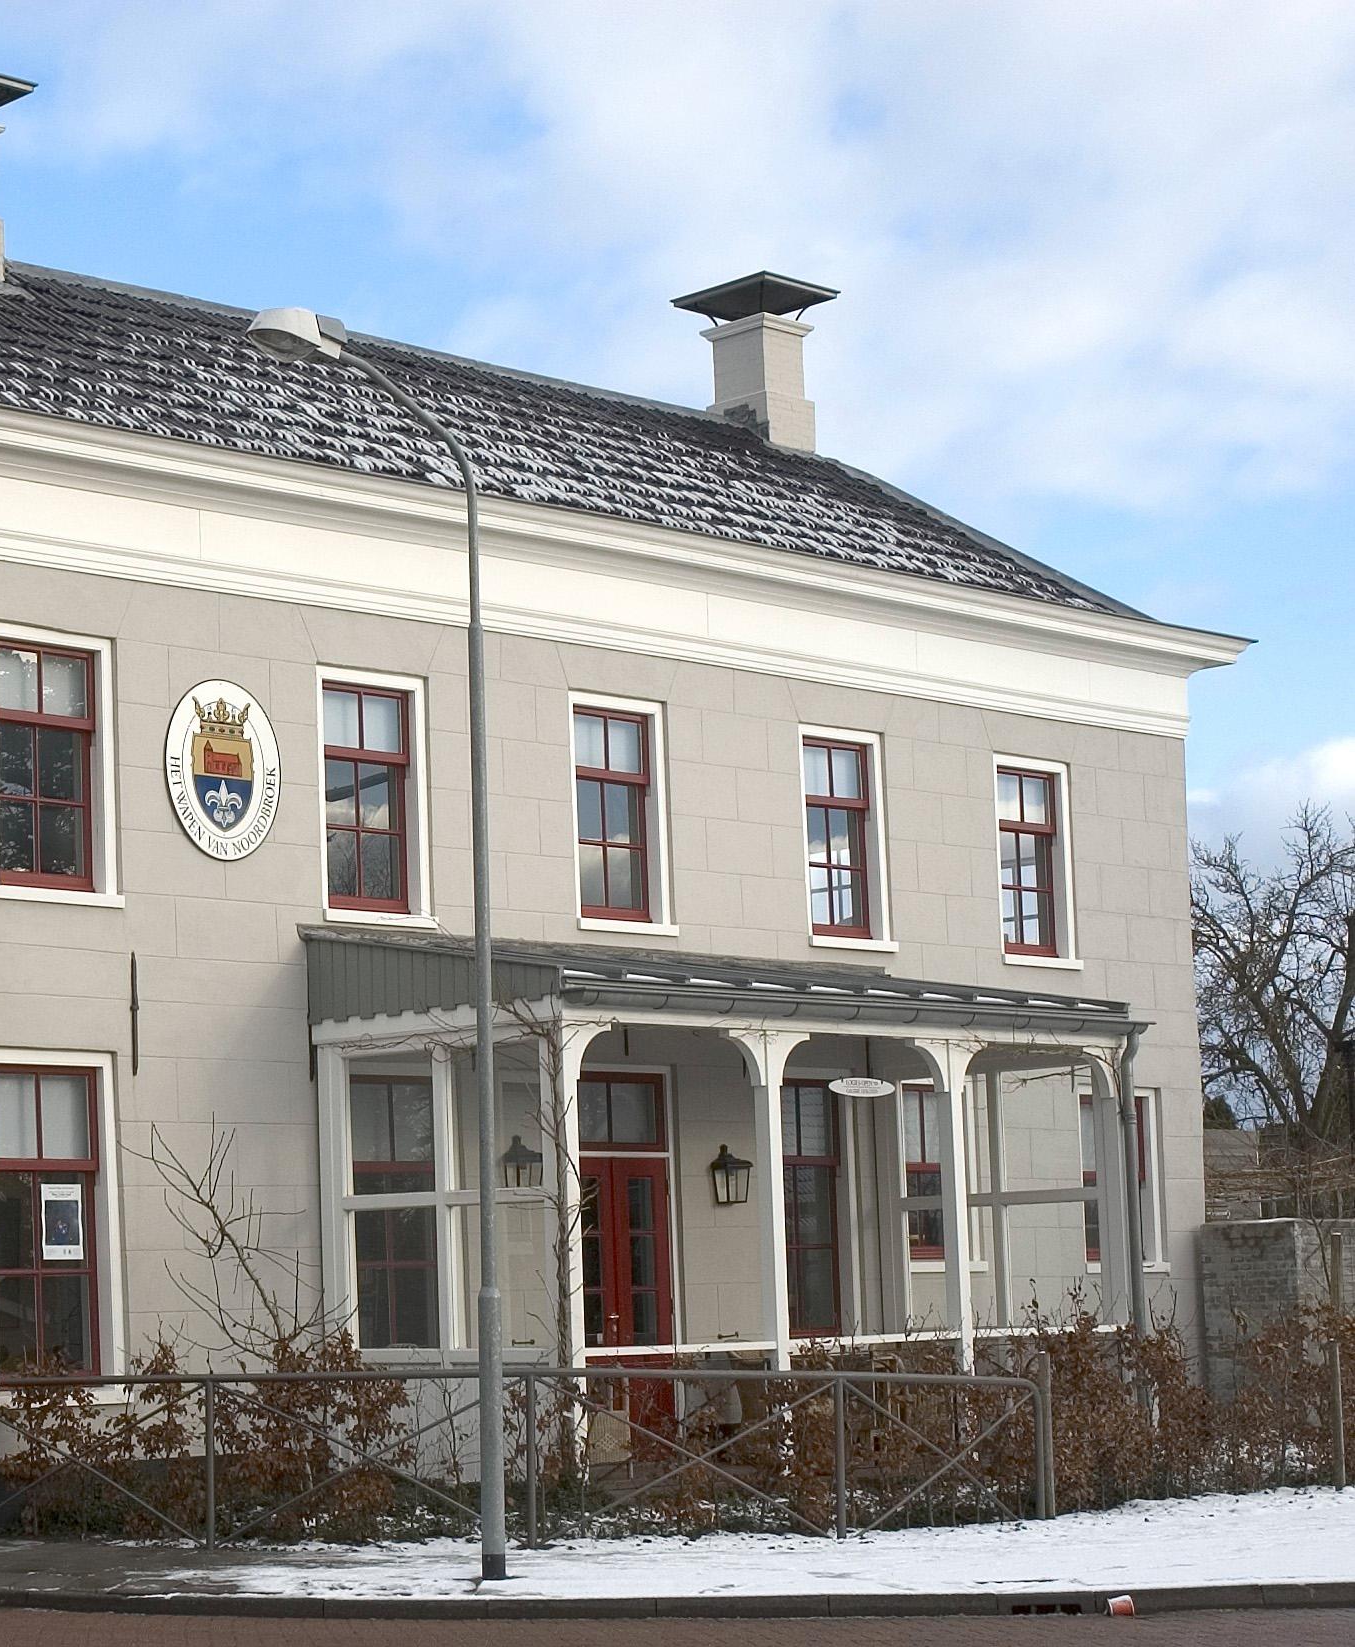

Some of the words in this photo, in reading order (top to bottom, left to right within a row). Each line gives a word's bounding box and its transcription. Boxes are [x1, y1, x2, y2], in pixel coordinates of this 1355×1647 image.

[170, 755, 183, 788] HET
[175, 790, 206, 841] WAPEN
[232, 767, 277, 856] NOORDBROEK
[207, 835, 228, 857] VAN
